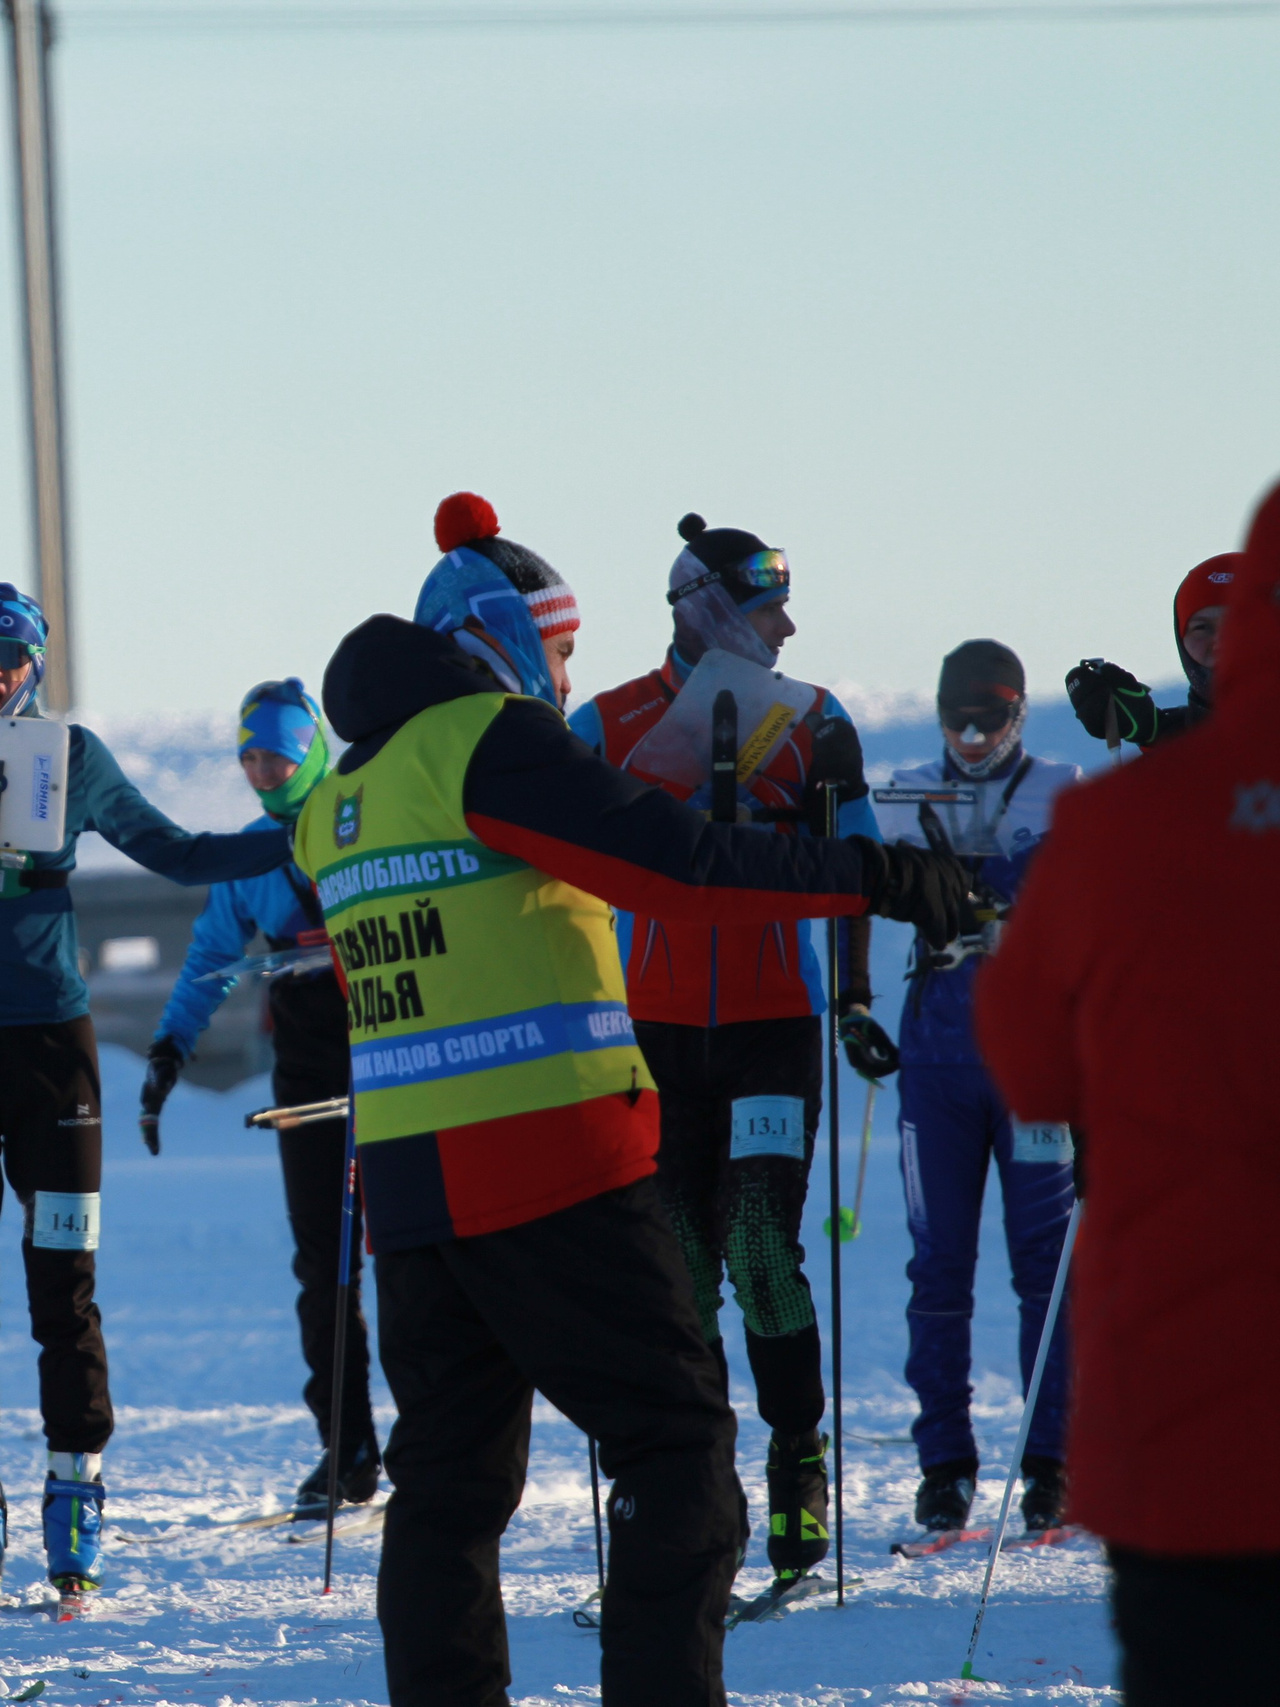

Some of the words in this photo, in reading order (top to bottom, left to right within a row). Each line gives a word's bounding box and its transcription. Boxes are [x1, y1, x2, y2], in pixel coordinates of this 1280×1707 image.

[38, 770, 49, 820] FISHIAN
[362, 847, 480, 892] ОБЛАСТЬ
[373, 1039, 441, 1077] ВИДОВ
[444, 1020, 544, 1064] СПОРТА
[748, 1115, 788, 1136] 13.1
[1031, 1128, 1067, 1145] 18.1
[52, 1212, 90, 1232] 14.1
